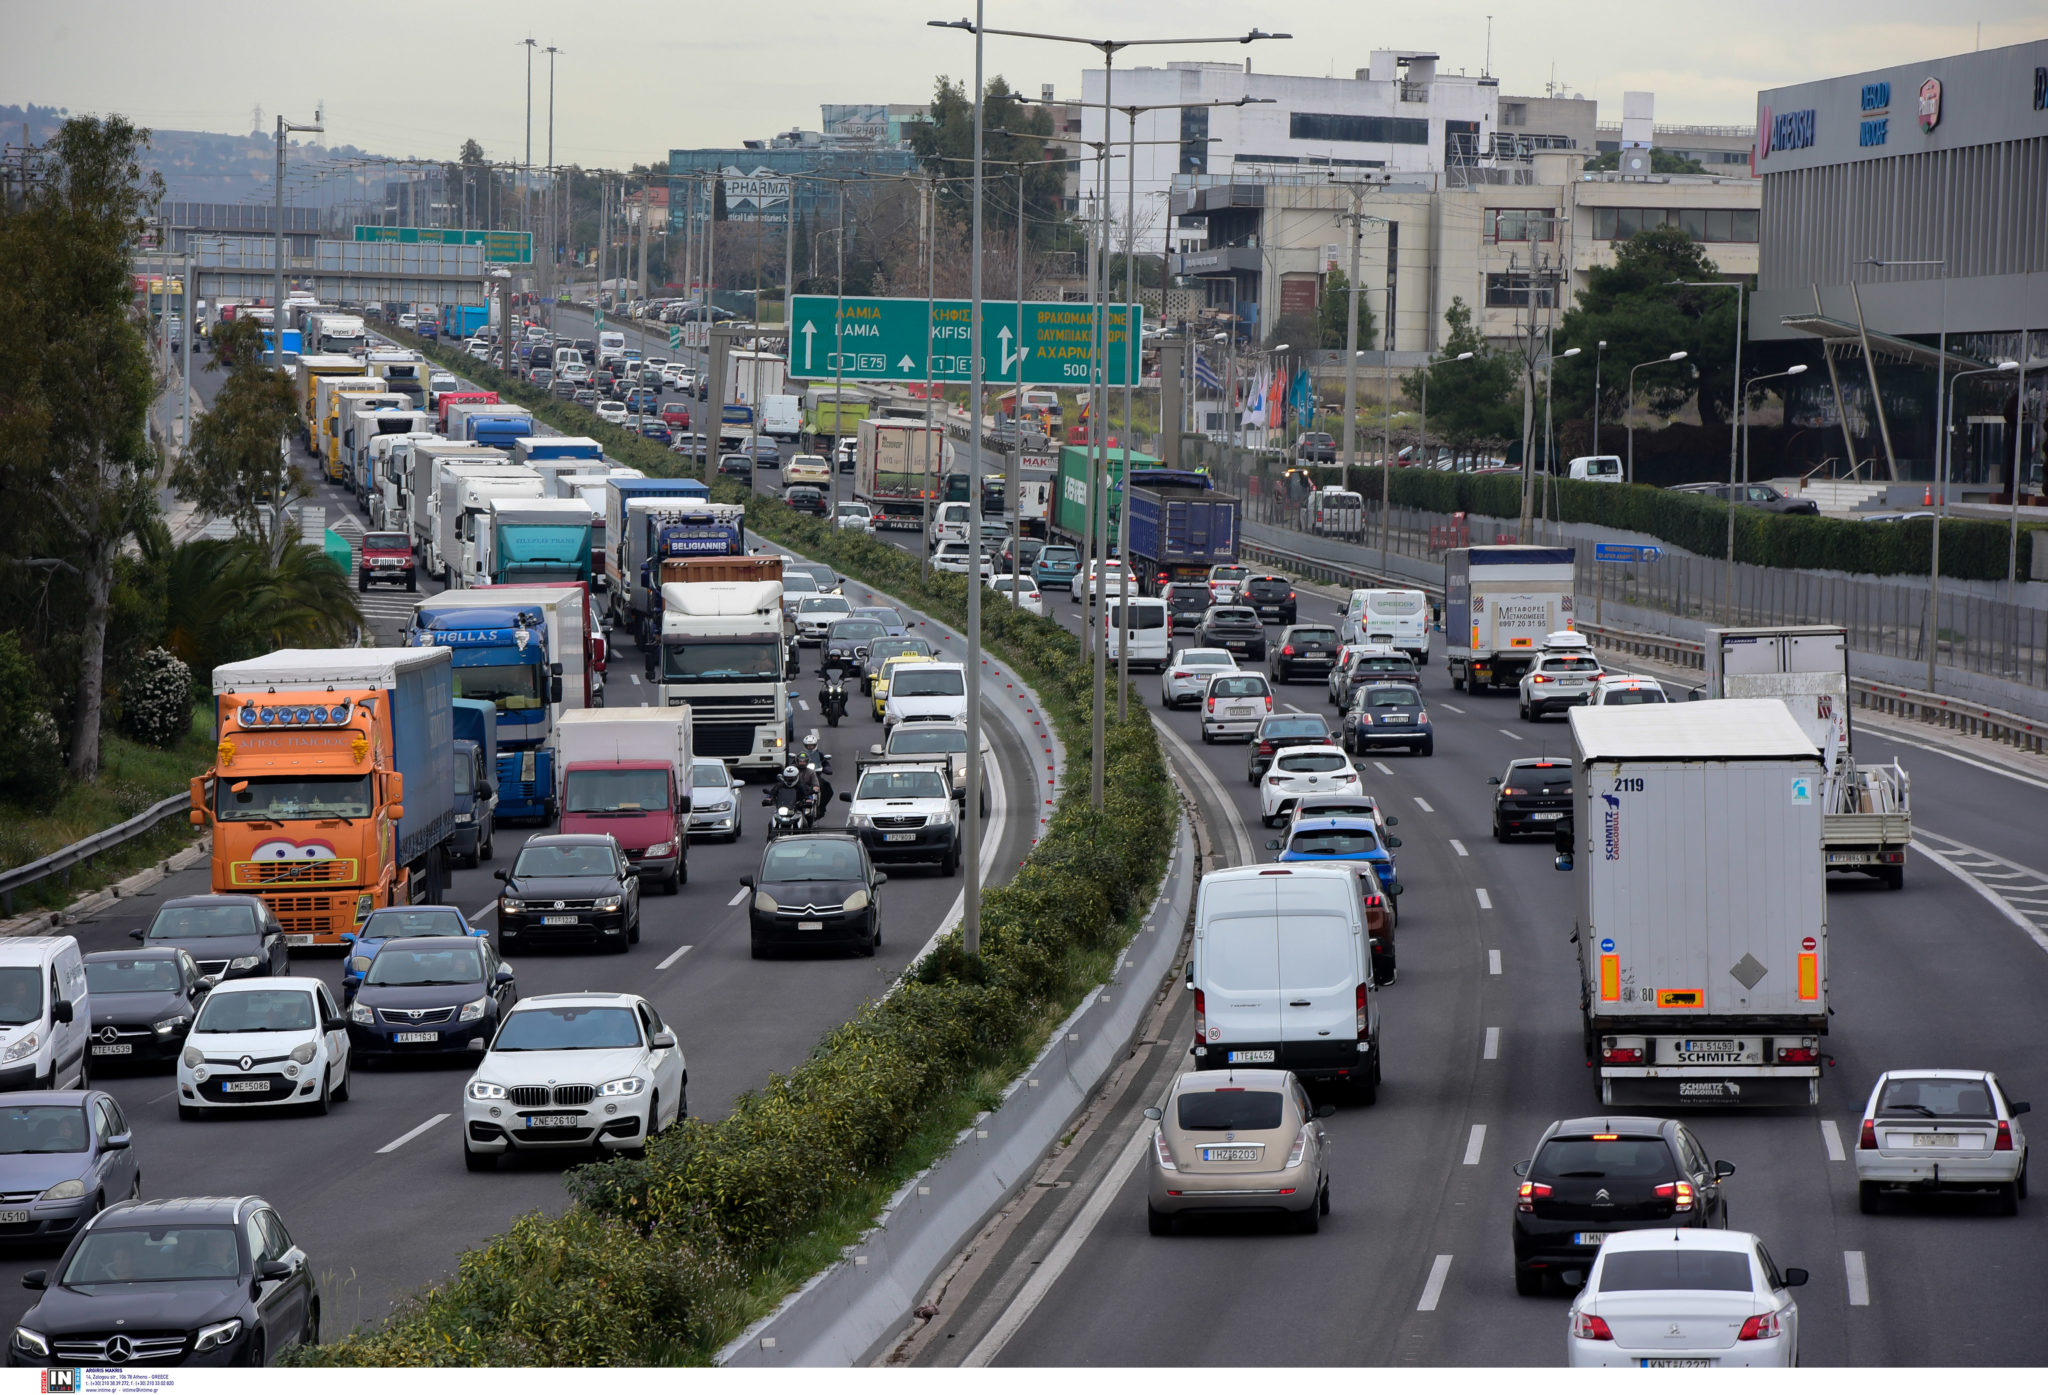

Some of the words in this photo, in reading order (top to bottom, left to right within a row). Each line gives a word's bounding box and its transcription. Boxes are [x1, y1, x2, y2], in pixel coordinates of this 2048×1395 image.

[835, 324, 880, 337] LAMIA
[932, 326, 972, 339] KIFISI
[870, 358, 883, 369] 75
[1064, 364, 1087, 376] 500
[672, 541, 727, 550] BELIGIANNIS
[437, 630, 498, 643] HELLAS
[1614, 778, 1644, 792] 2119
[1605, 811, 1614, 861] SCHMITZ
[1642, 988, 1653, 1002] 80
[1210, 1030, 1218, 1038] 90
[1678, 1053, 1742, 1062] SCHMITZ
